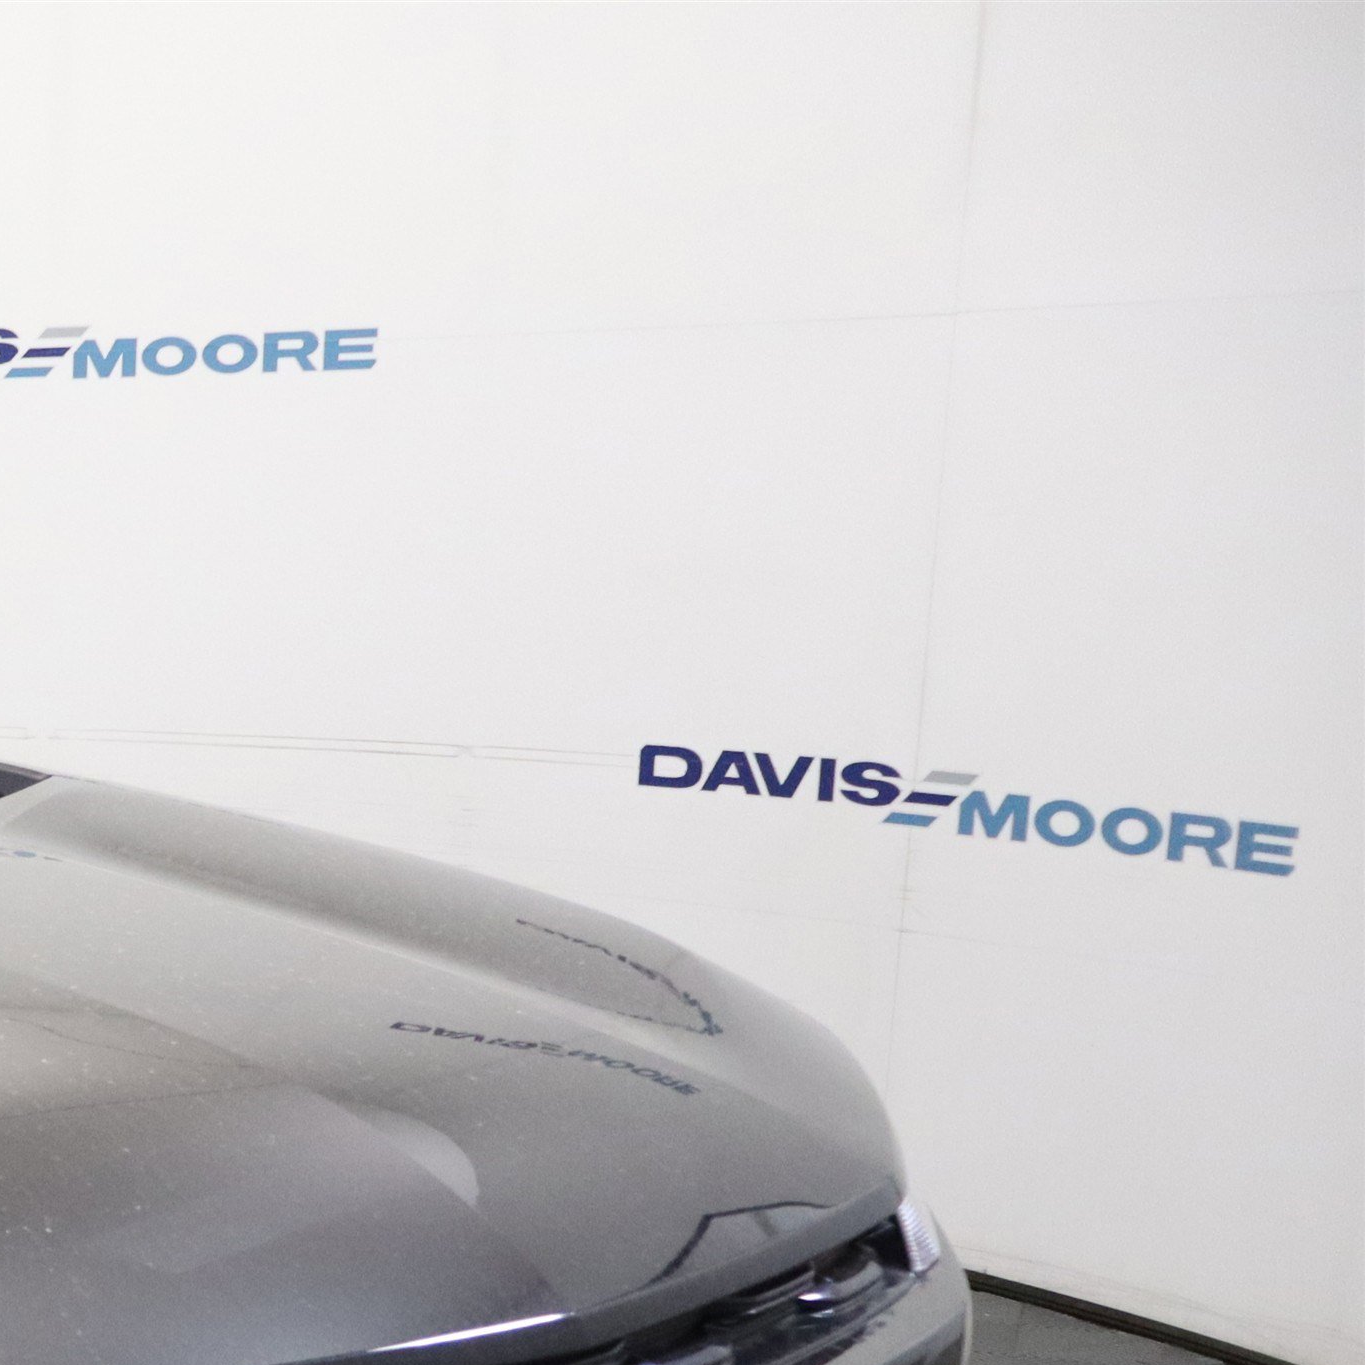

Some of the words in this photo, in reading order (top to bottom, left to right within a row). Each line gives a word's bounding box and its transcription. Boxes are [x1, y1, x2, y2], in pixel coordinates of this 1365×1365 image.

[72, 328, 378, 378] MOORE
[638, 745, 900, 808] DAVIS
[957, 789, 1299, 877] MOORE
